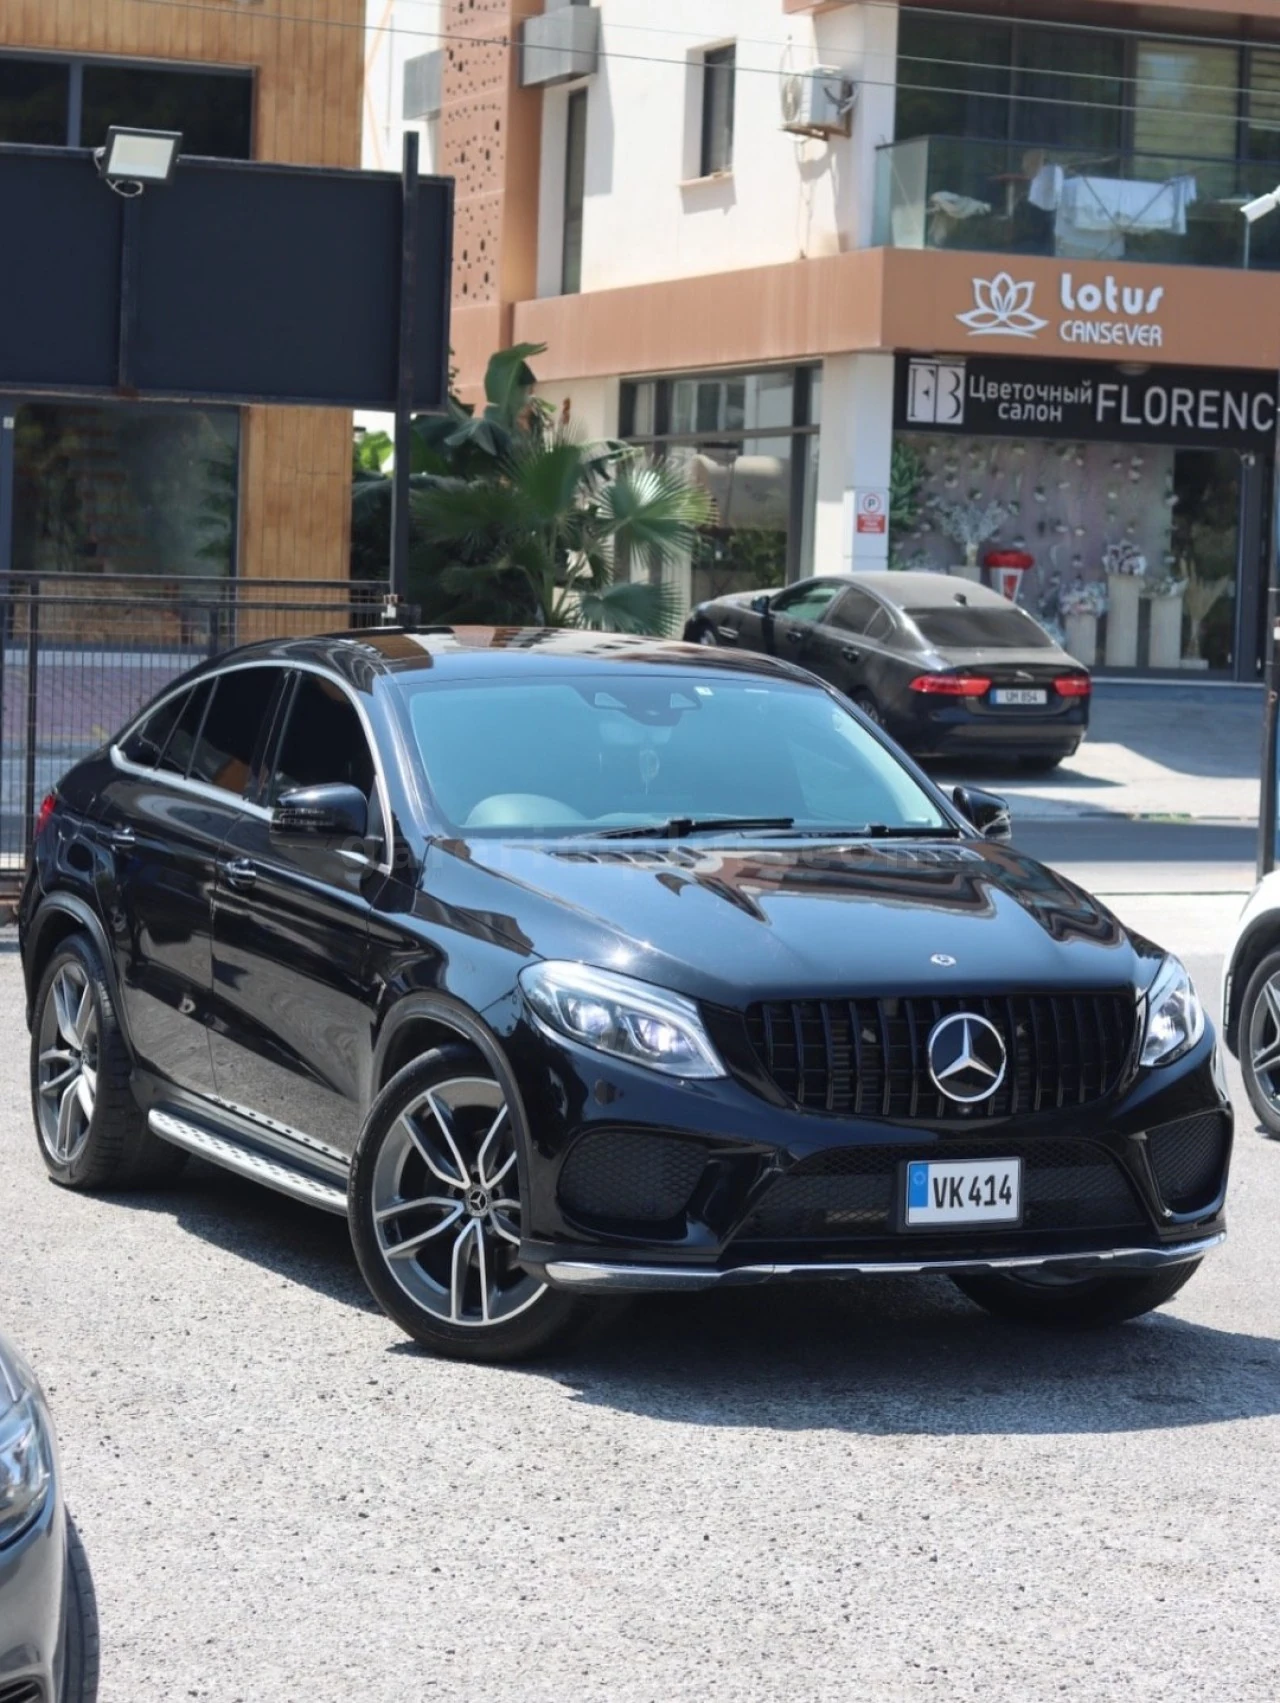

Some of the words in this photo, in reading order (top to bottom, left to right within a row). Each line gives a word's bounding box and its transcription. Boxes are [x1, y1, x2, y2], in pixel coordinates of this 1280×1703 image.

[1060, 320, 1163, 347] CANSEVER
[969, 374, 1093, 404] Цветочный
[998, 402, 1063, 423] салон
